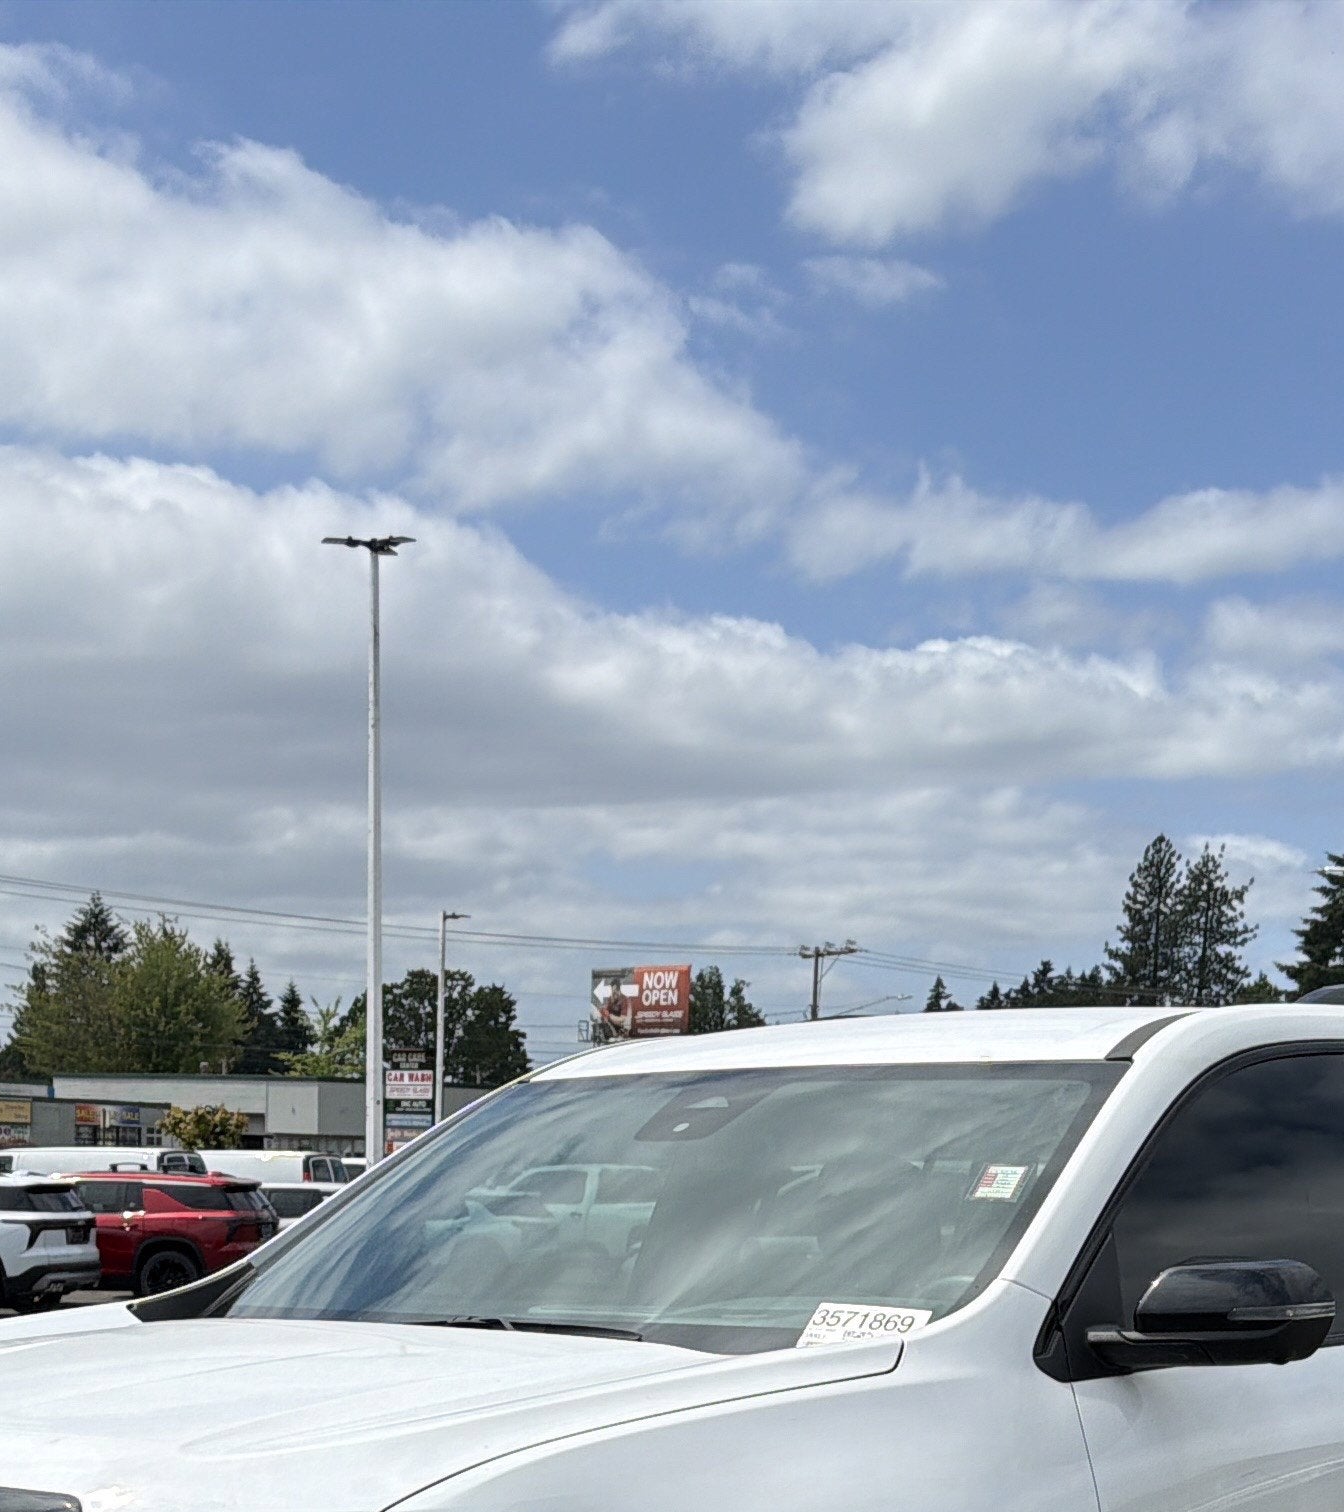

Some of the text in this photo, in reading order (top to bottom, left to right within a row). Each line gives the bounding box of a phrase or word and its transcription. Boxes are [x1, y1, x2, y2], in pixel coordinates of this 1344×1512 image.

[642, 970, 679, 989] NOW
[641, 988, 678, 1007] OPEN
[387, 1072, 432, 1082] CAR WASH
[813, 1309, 915, 1334] 3571869
